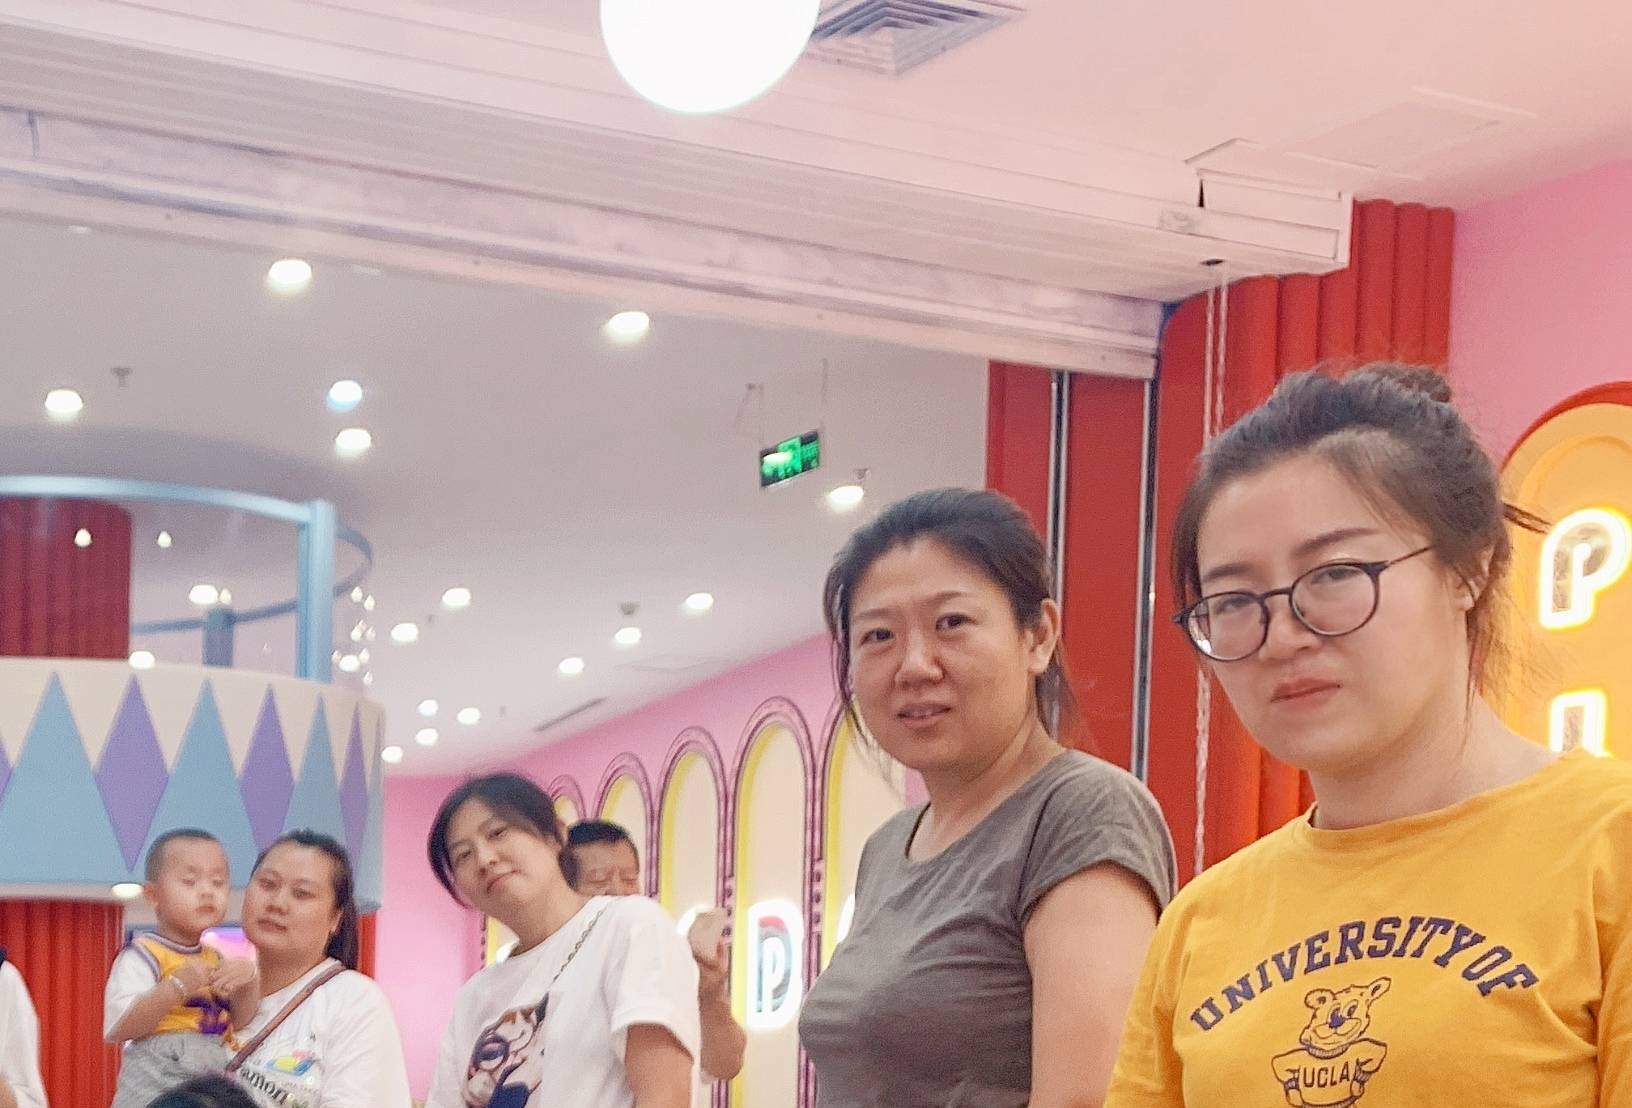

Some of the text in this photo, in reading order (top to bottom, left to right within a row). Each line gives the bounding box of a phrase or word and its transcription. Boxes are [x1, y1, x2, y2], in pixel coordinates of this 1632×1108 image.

[1189, 915, 1539, 1032] UNIVERSITY OF
[1302, 1059, 1352, 1089] UCLA
